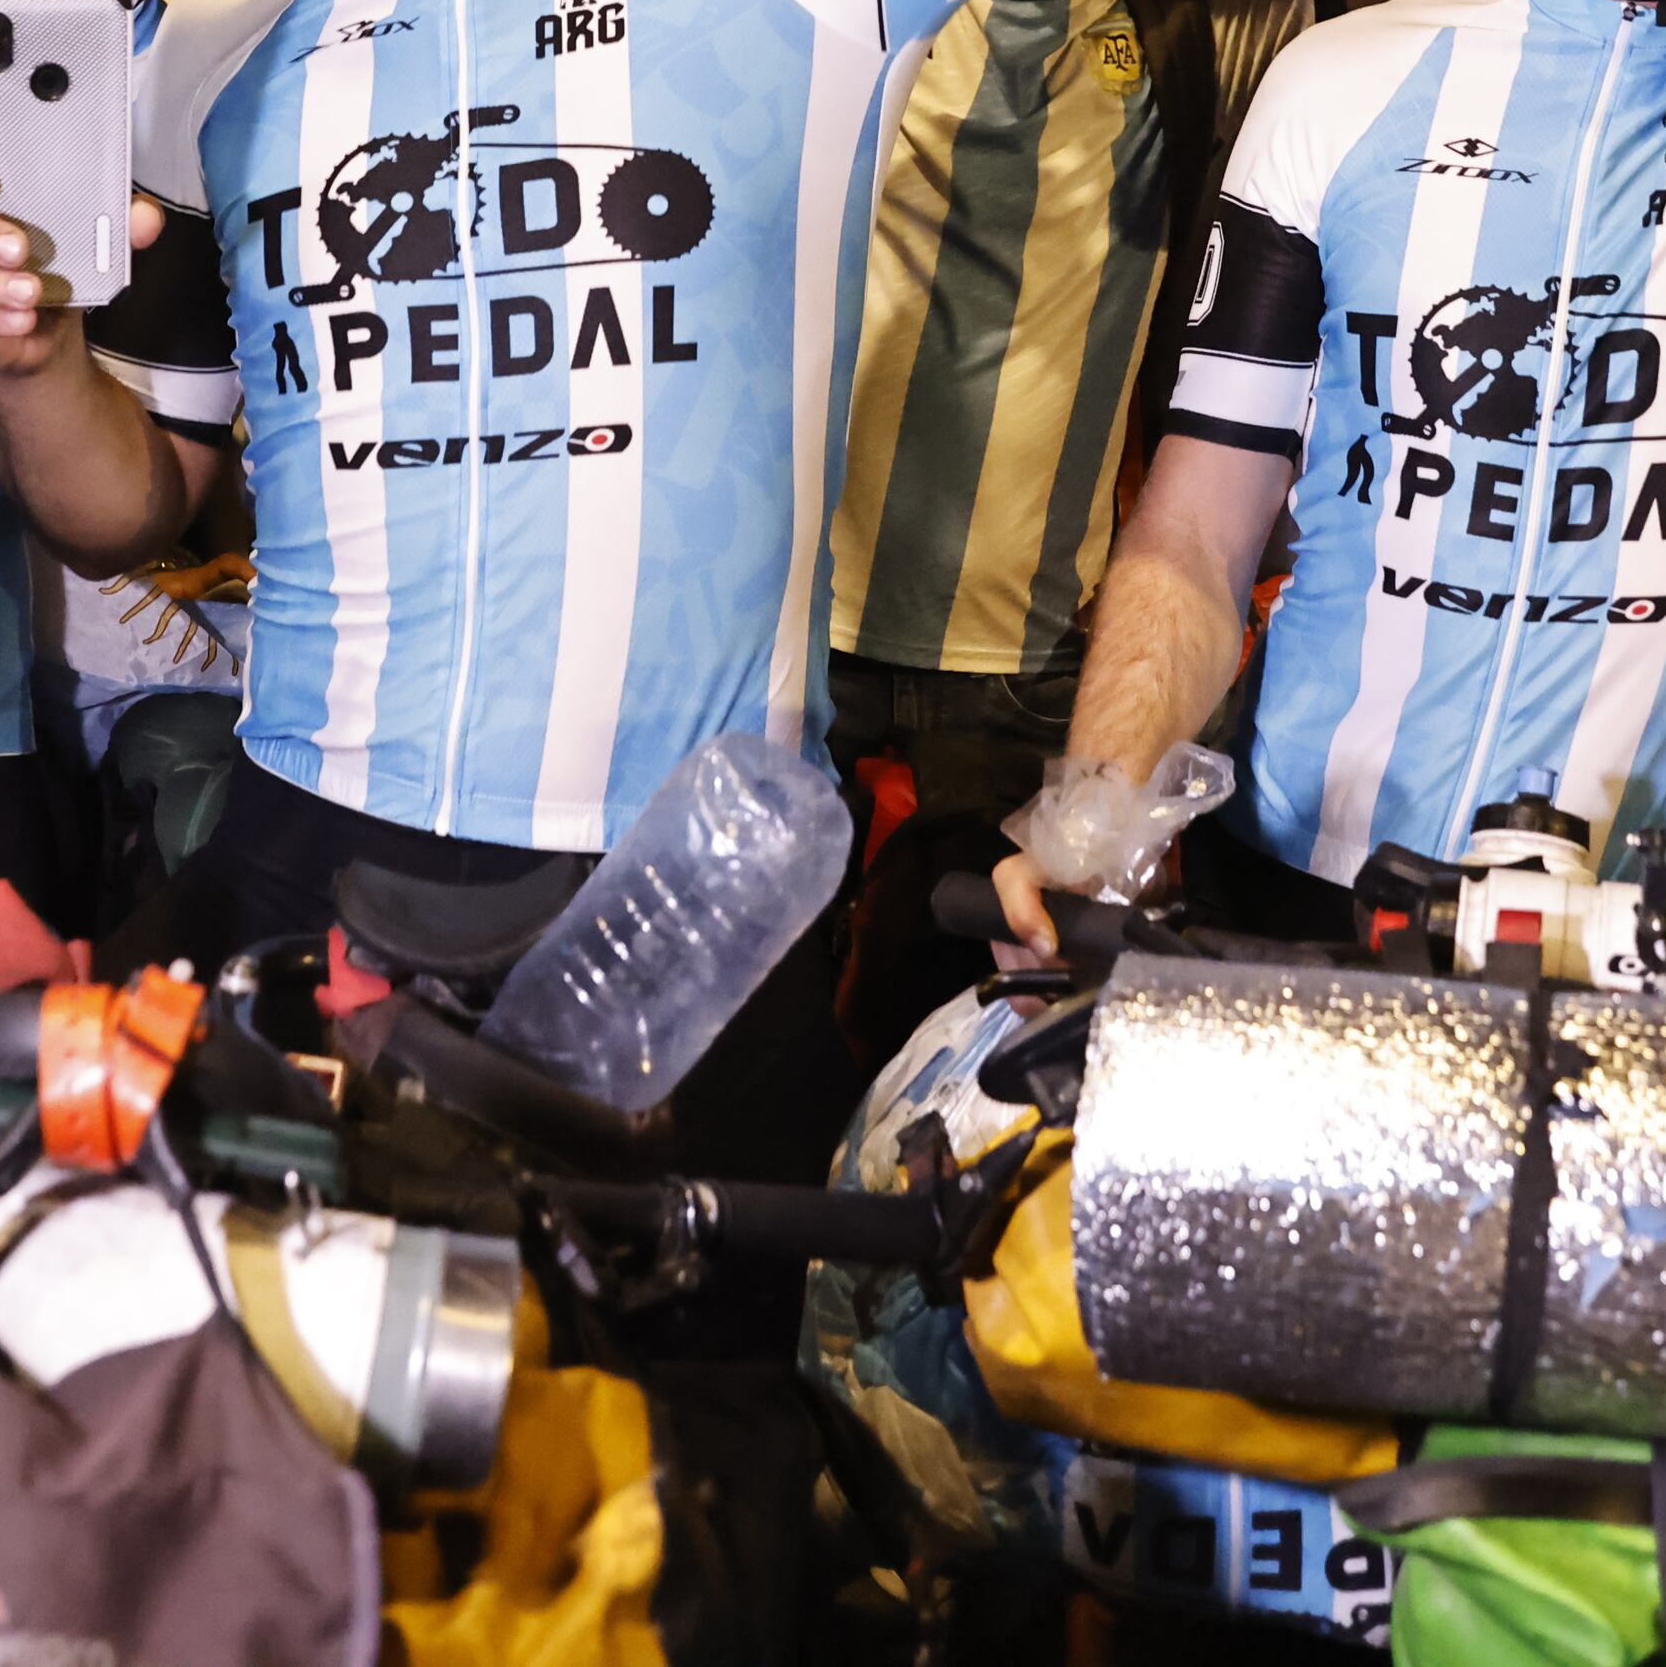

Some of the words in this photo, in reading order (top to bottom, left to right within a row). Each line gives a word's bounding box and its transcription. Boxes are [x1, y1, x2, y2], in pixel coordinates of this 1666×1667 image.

[534, 1, 625, 59] ARG
[1103, 33, 1137, 72] AFA
[329, 423, 633, 471] venzo
[1074, 1504, 1388, 1594] PEDA
